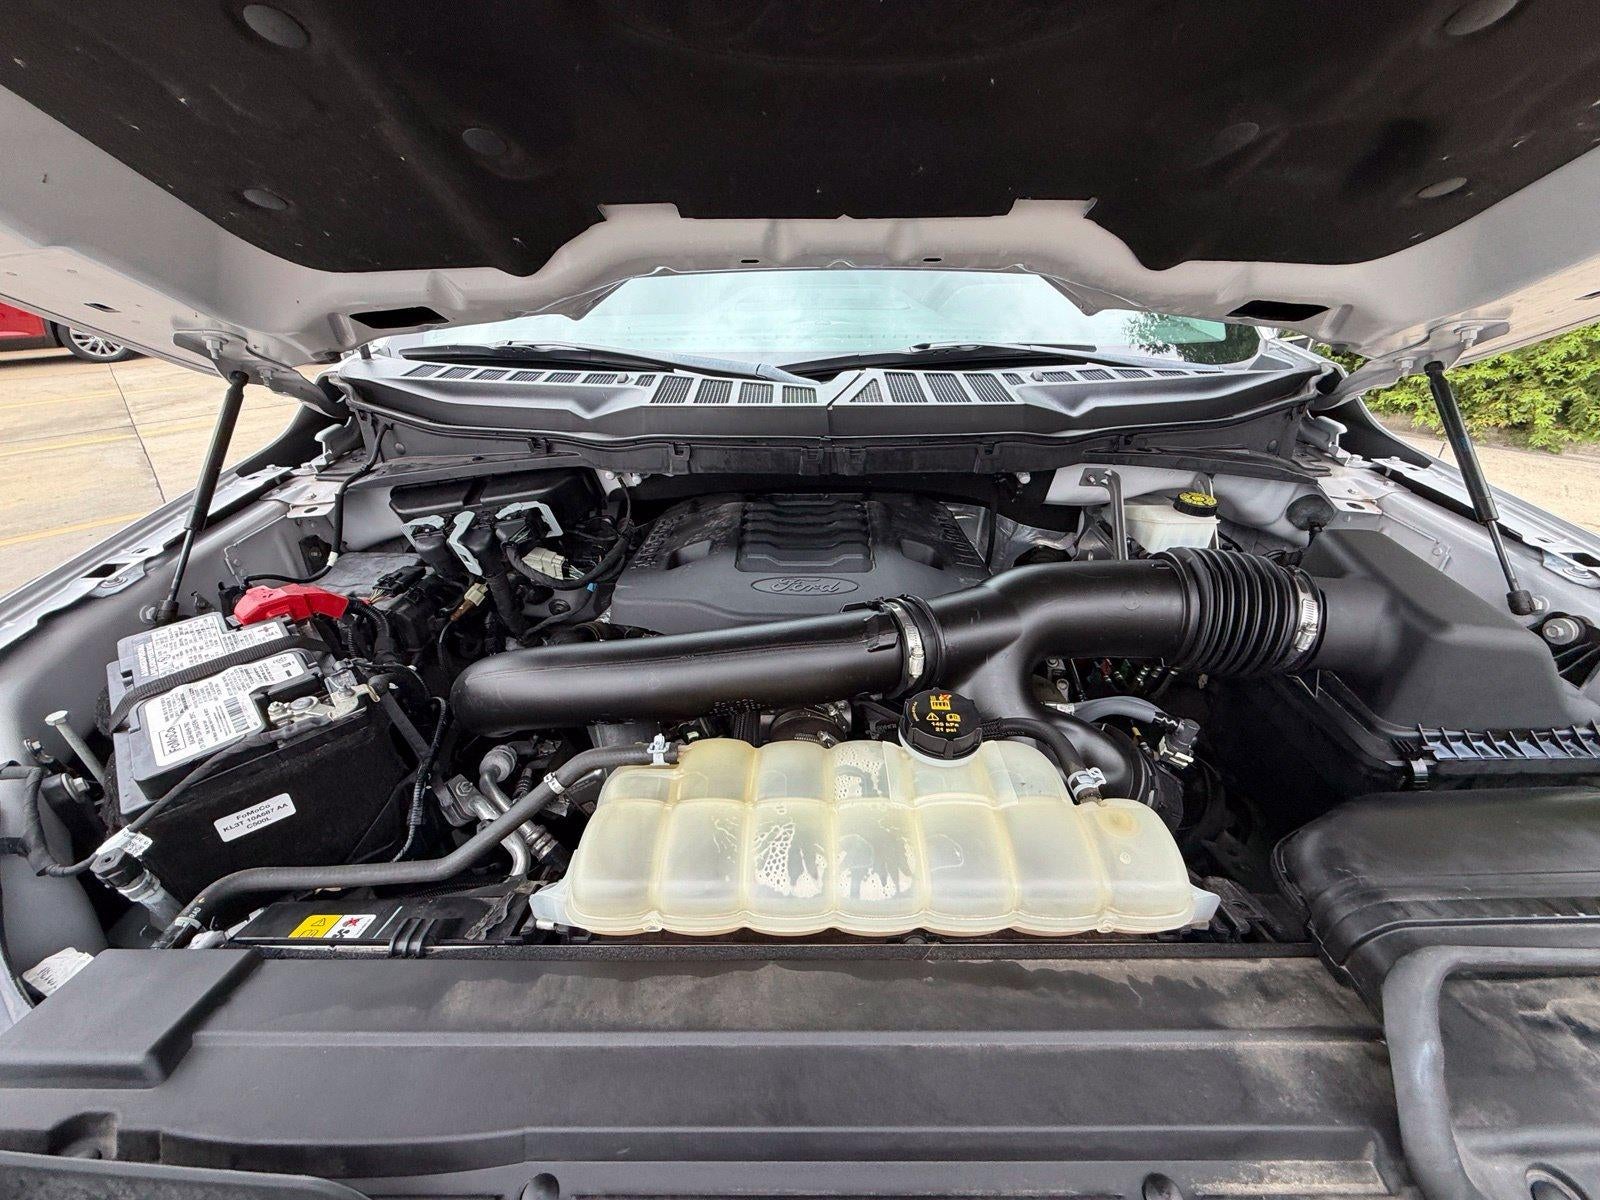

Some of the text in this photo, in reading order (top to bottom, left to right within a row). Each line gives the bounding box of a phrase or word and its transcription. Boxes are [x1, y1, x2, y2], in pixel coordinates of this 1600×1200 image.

[771, 578, 840, 592] Ford
[223, 821, 244, 832] KL3T
[276, 803, 289, 811] AA
[236, 804, 271, 820] FoMoCo
[246, 817, 272, 829] C500L
